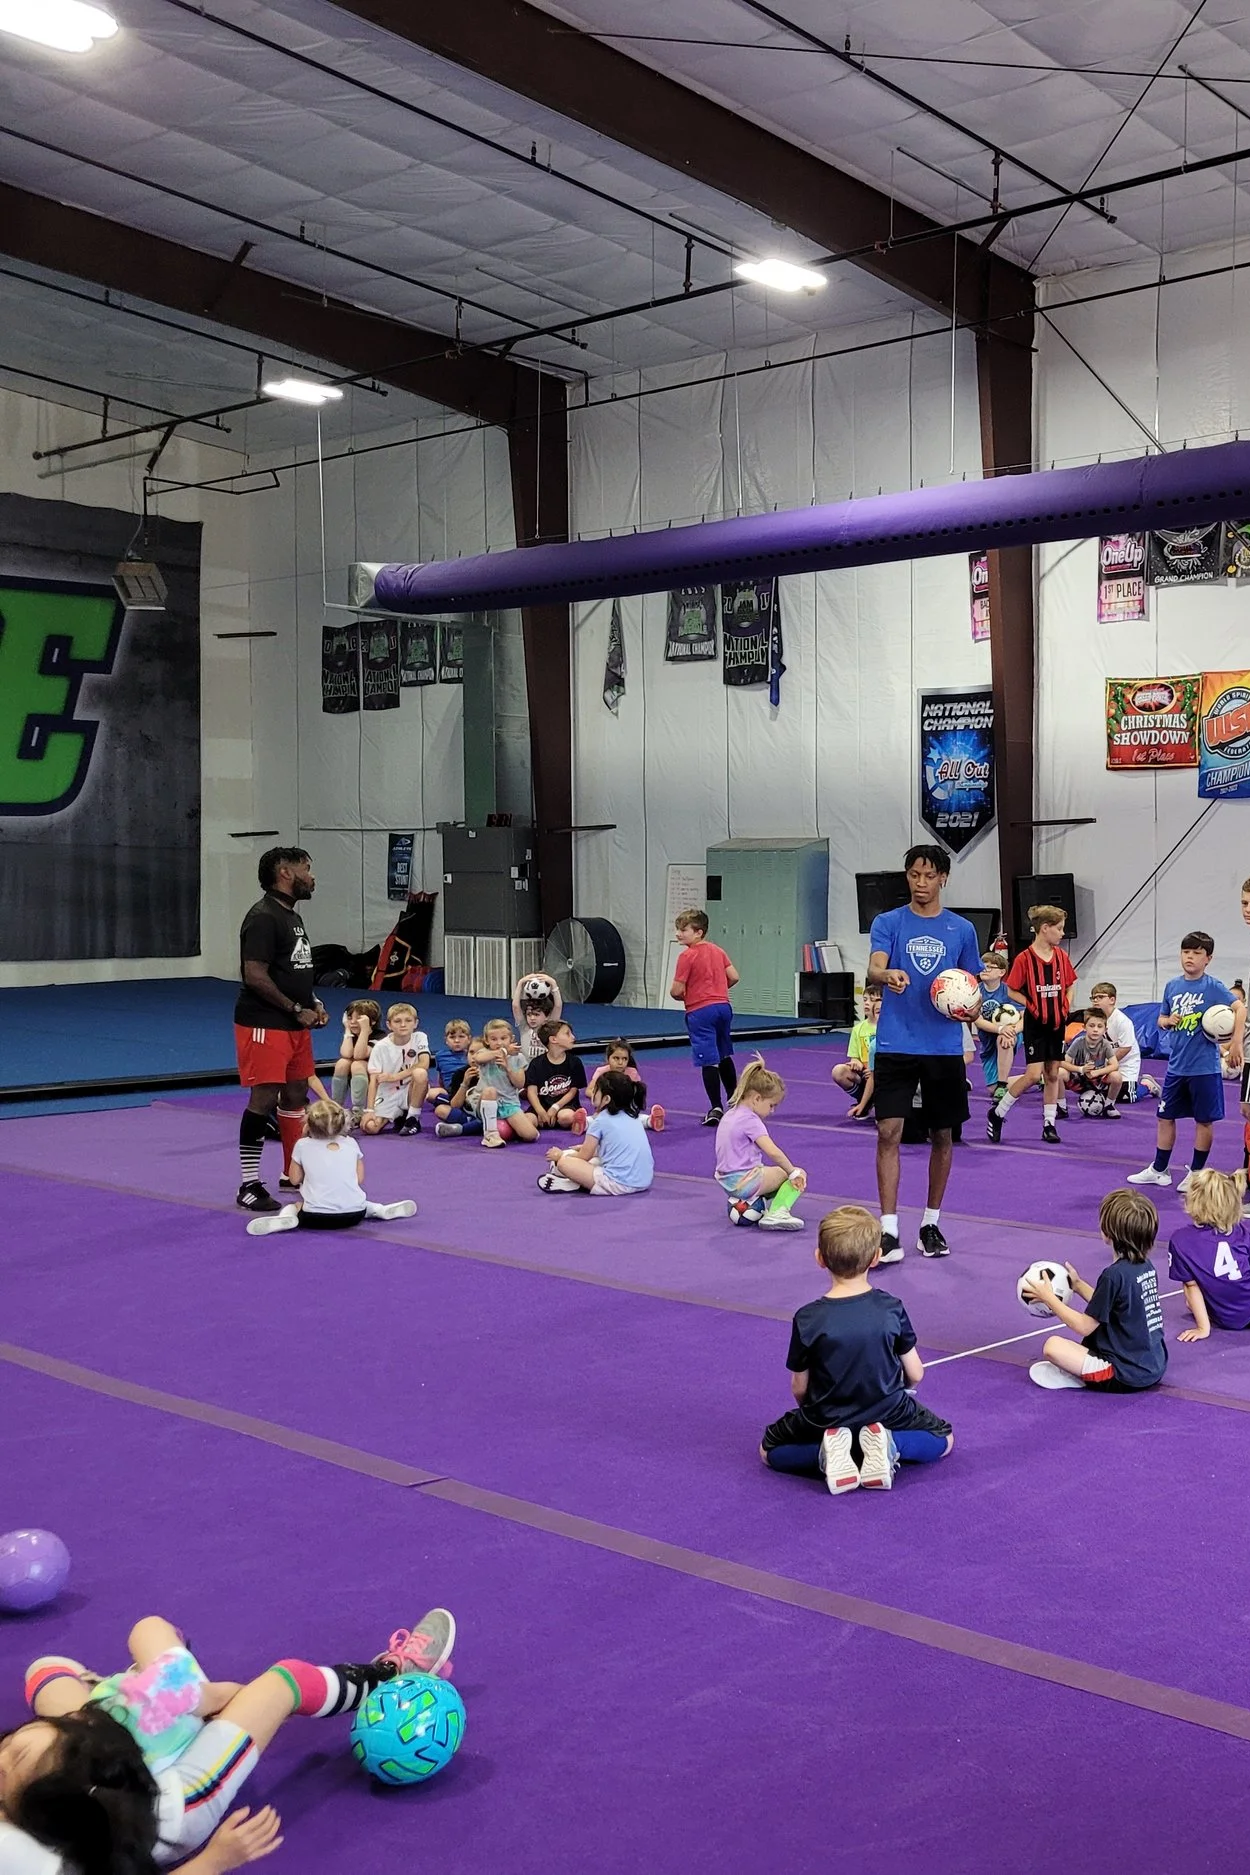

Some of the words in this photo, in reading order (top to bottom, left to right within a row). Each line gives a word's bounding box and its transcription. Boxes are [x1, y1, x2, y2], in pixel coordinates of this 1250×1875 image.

[1103, 541, 1143, 568] OneUp
[1154, 575, 1179, 584] GRAND
[1180, 571, 1214, 582] CHAMPION
[1117, 581, 1142, 598] PLACE
[923, 700, 994, 717] NATIONAL
[923, 715, 994, 731] CHAMPION
[1121, 713, 1188, 731] CHRISTMAS
[1113, 729, 1190, 746] SHOWDOWN
[937, 760, 960, 782] All
[963, 760, 989, 779] Out
[936, 811, 980, 828] 2021
[909, 945, 944, 953] TENNESSEE
[1180, 992, 1204, 1007] CALL
[1213, 1241, 1243, 1281] 4
